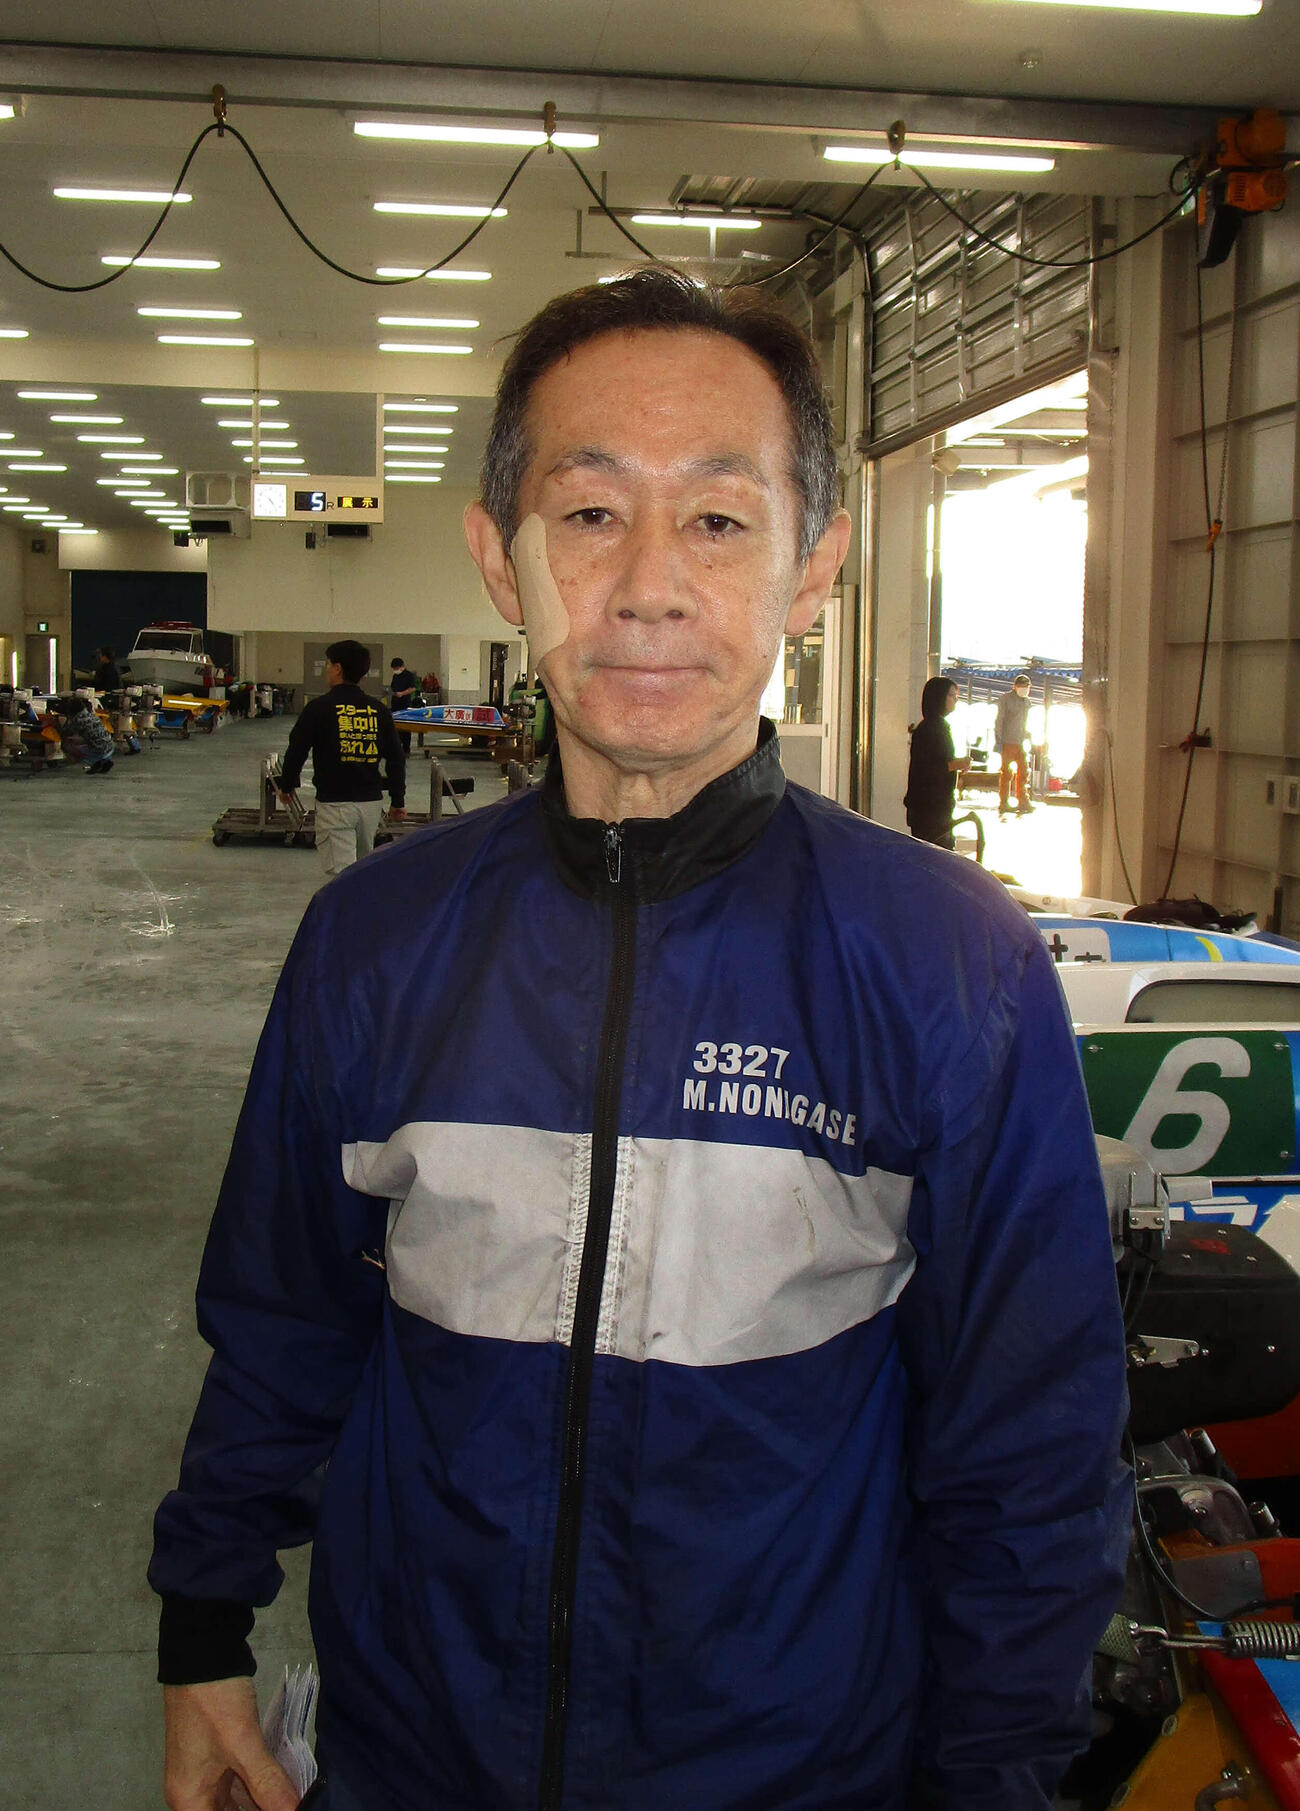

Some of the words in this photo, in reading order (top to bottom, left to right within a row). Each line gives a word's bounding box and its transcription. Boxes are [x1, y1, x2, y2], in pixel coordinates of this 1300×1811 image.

[342, 497, 374, 508] 展示
[336, 705, 377, 715] スタート
[693, 1041, 790, 1080] 3327
[1123, 1037, 1251, 1175] 6
